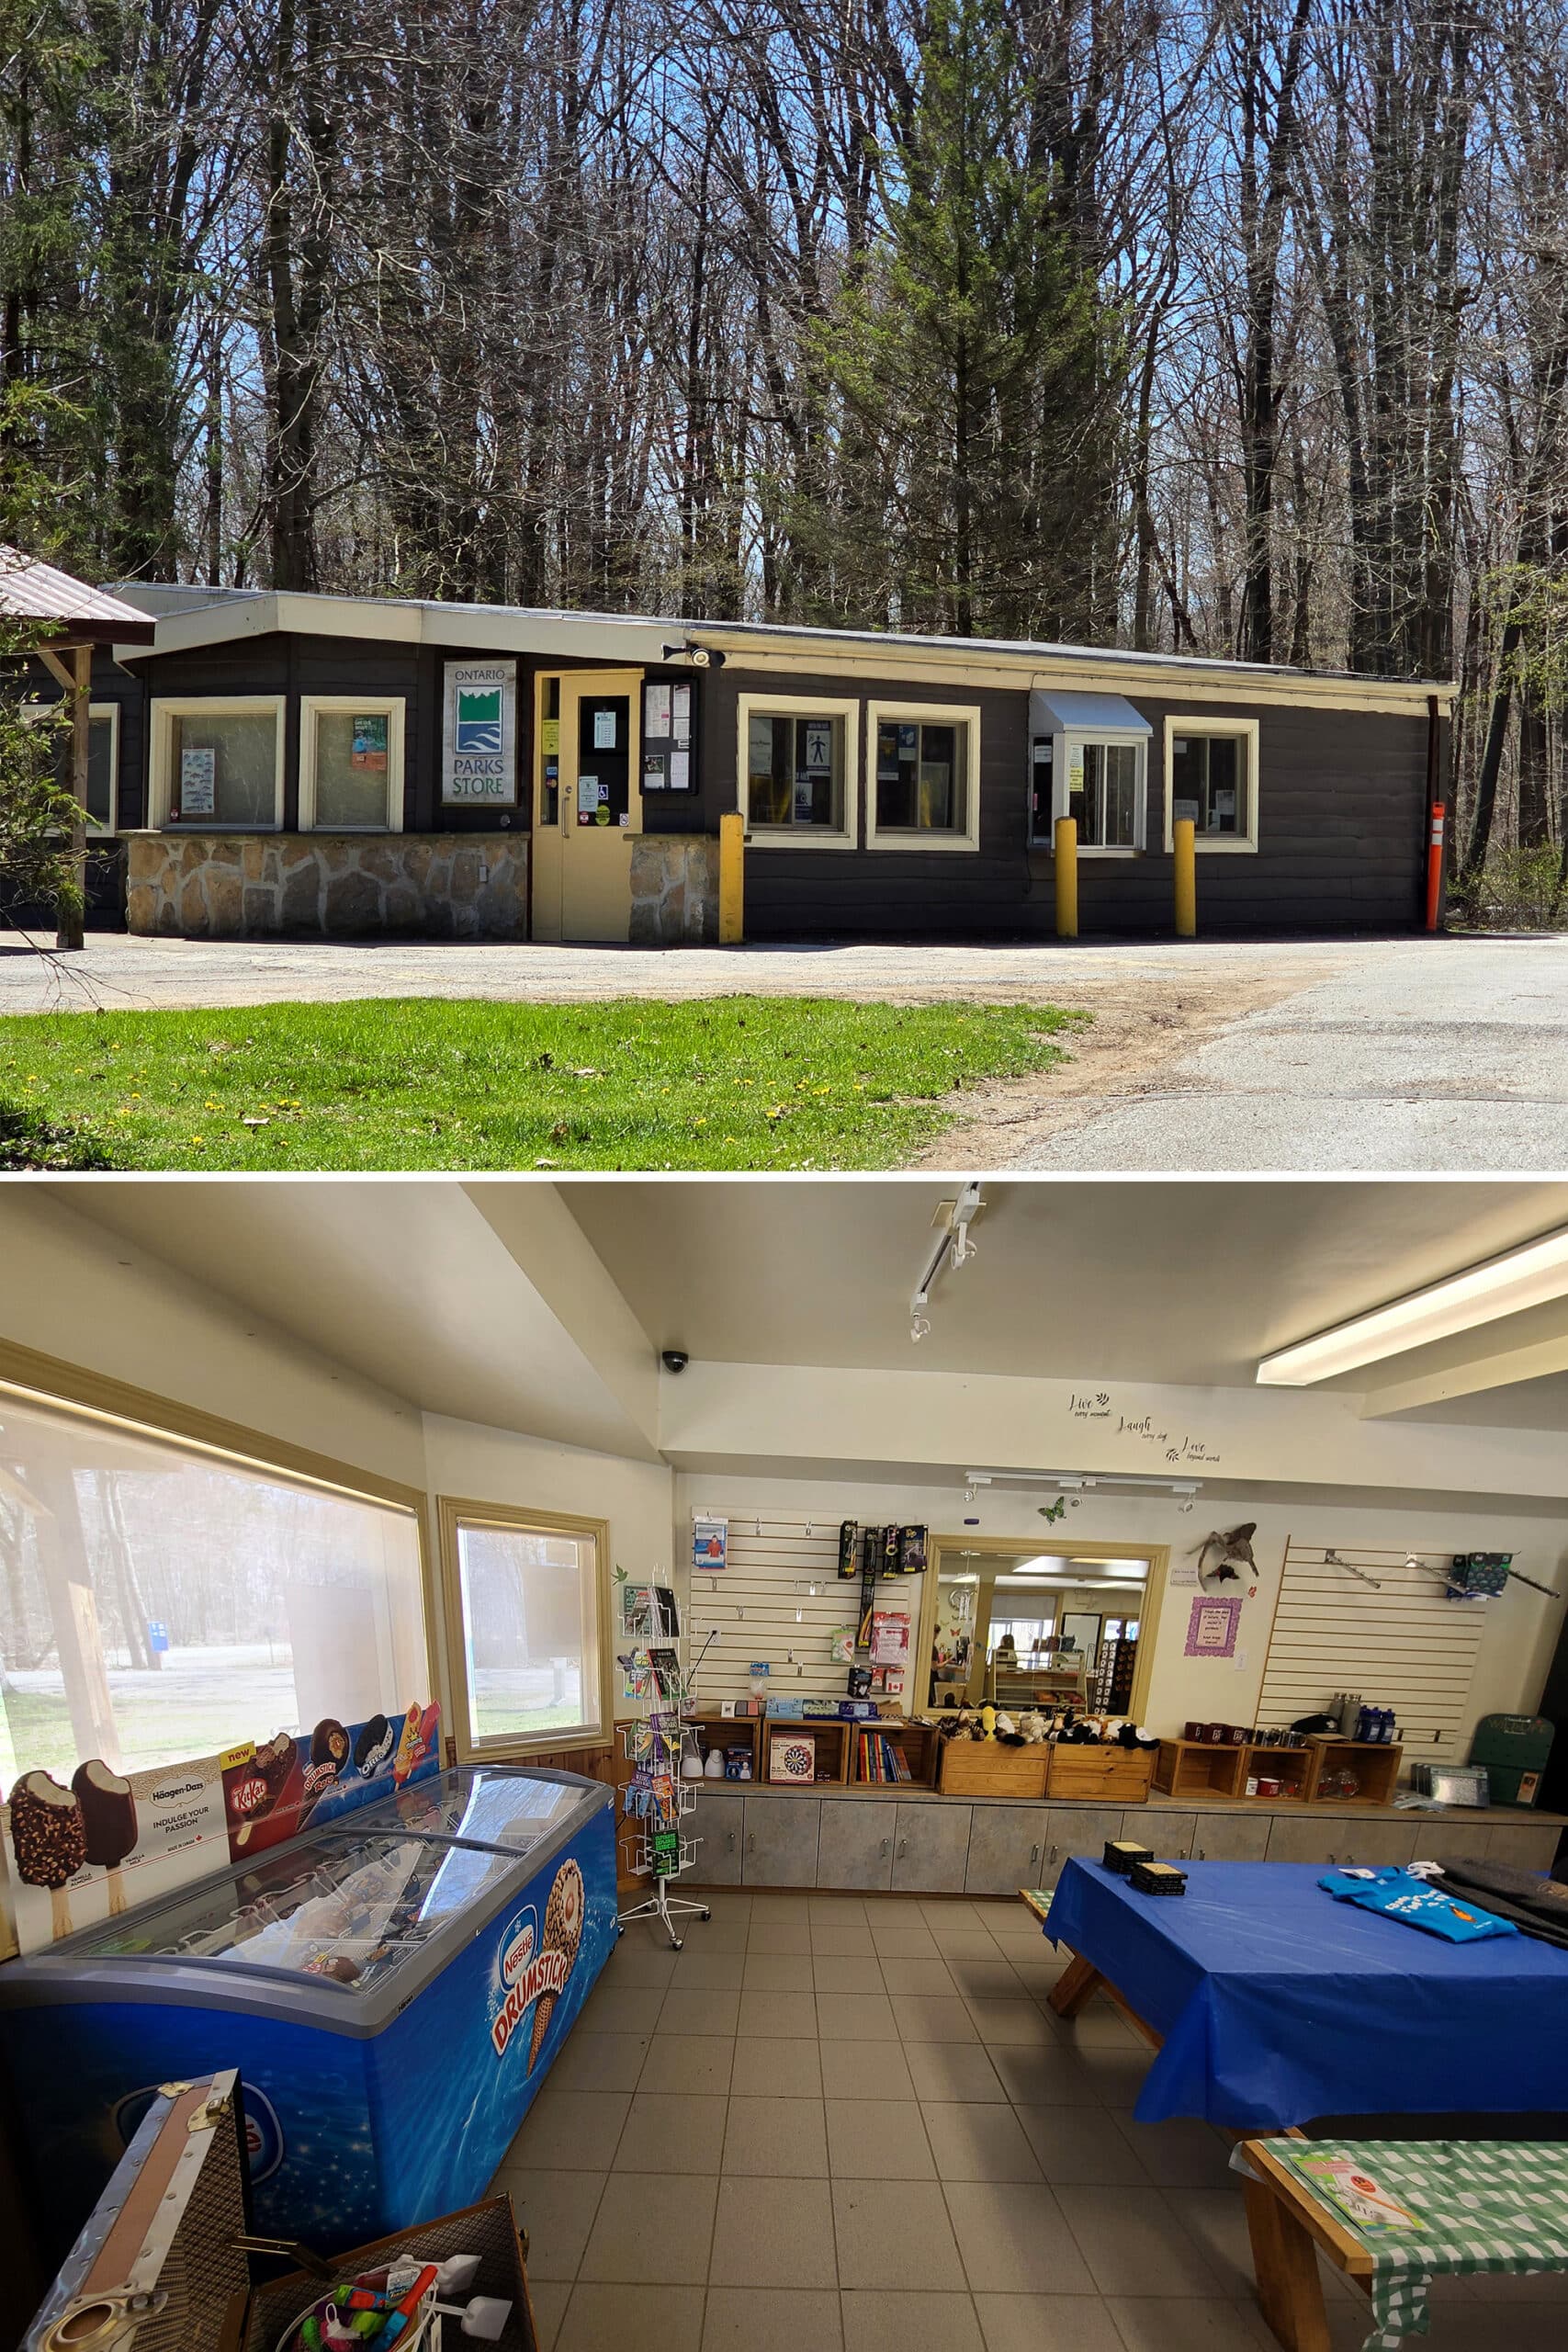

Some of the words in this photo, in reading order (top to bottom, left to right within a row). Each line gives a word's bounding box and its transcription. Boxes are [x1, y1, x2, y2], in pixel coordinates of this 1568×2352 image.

[455, 669, 505, 681] ONTARIO
[454, 759, 504, 775] PARKS
[453, 777, 504, 795] STORE
[1069, 1394, 1092, 1411] Live
[1118, 1416, 1151, 1433] Laugh
[1181, 1436, 1205, 1453] Love
[227, 1748, 250, 1762] new
[361, 1751, 384, 1775] OREO
[304, 1762, 336, 1791] DRUMSTICK
[152, 1782, 204, 1802] Häagen-Dazs
[235, 1781, 265, 1809] KitKat
[153, 1813, 187, 1828] INDULGE
[188, 1806, 209, 1818] YOUR
[165, 1818, 198, 1833] PASSION
[504, 1932, 534, 1978] Nestlé
[493, 1953, 567, 2050] DRUMSTICK
